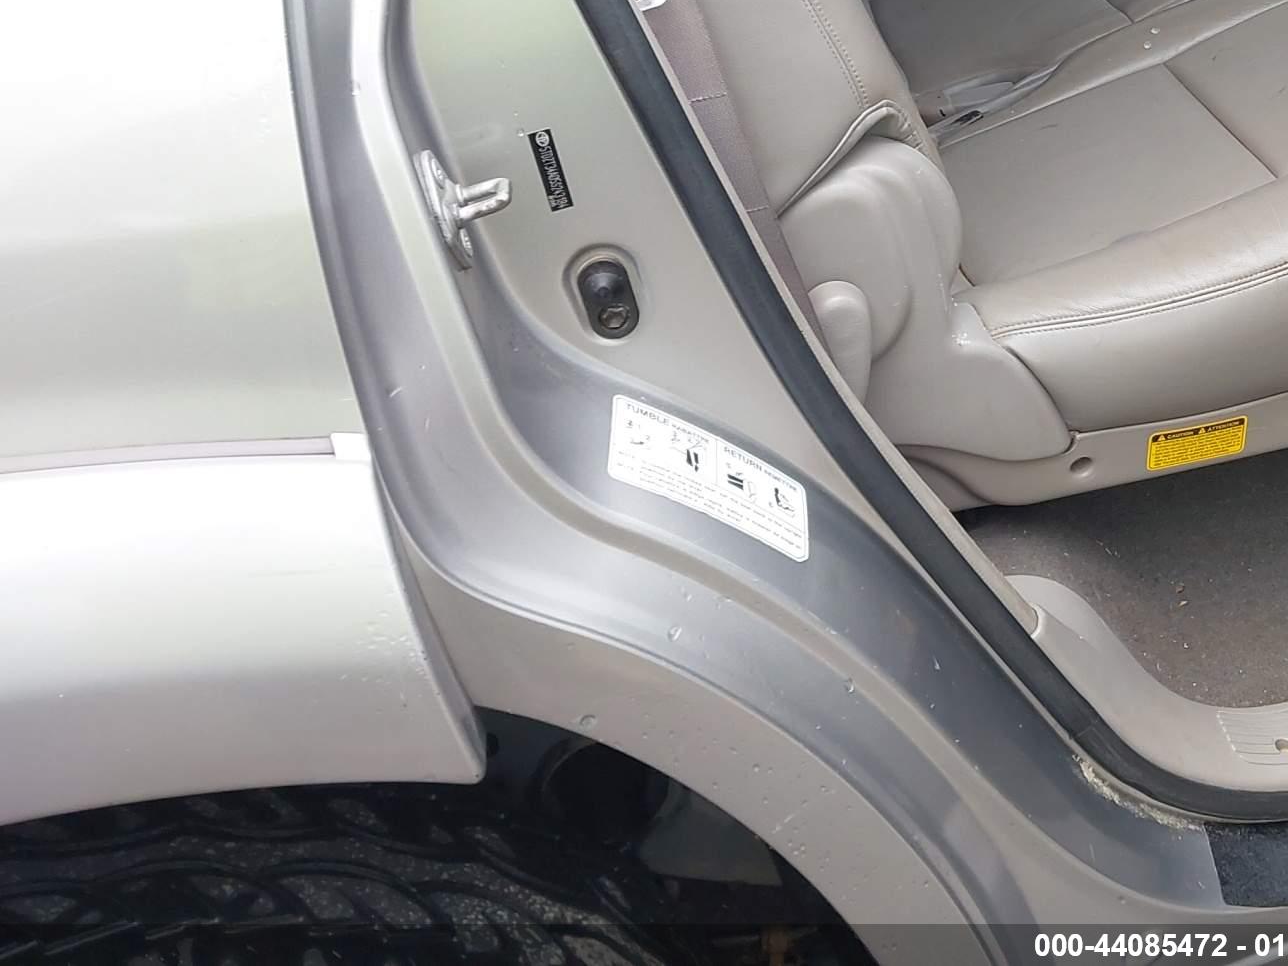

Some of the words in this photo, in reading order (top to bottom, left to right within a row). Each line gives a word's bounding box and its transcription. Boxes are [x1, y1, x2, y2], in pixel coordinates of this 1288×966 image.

[626, 403, 670, 425] TUMBLE
[1166, 431, 1194, 439] CAUTION
[723, 446, 762, 472] RETURN
